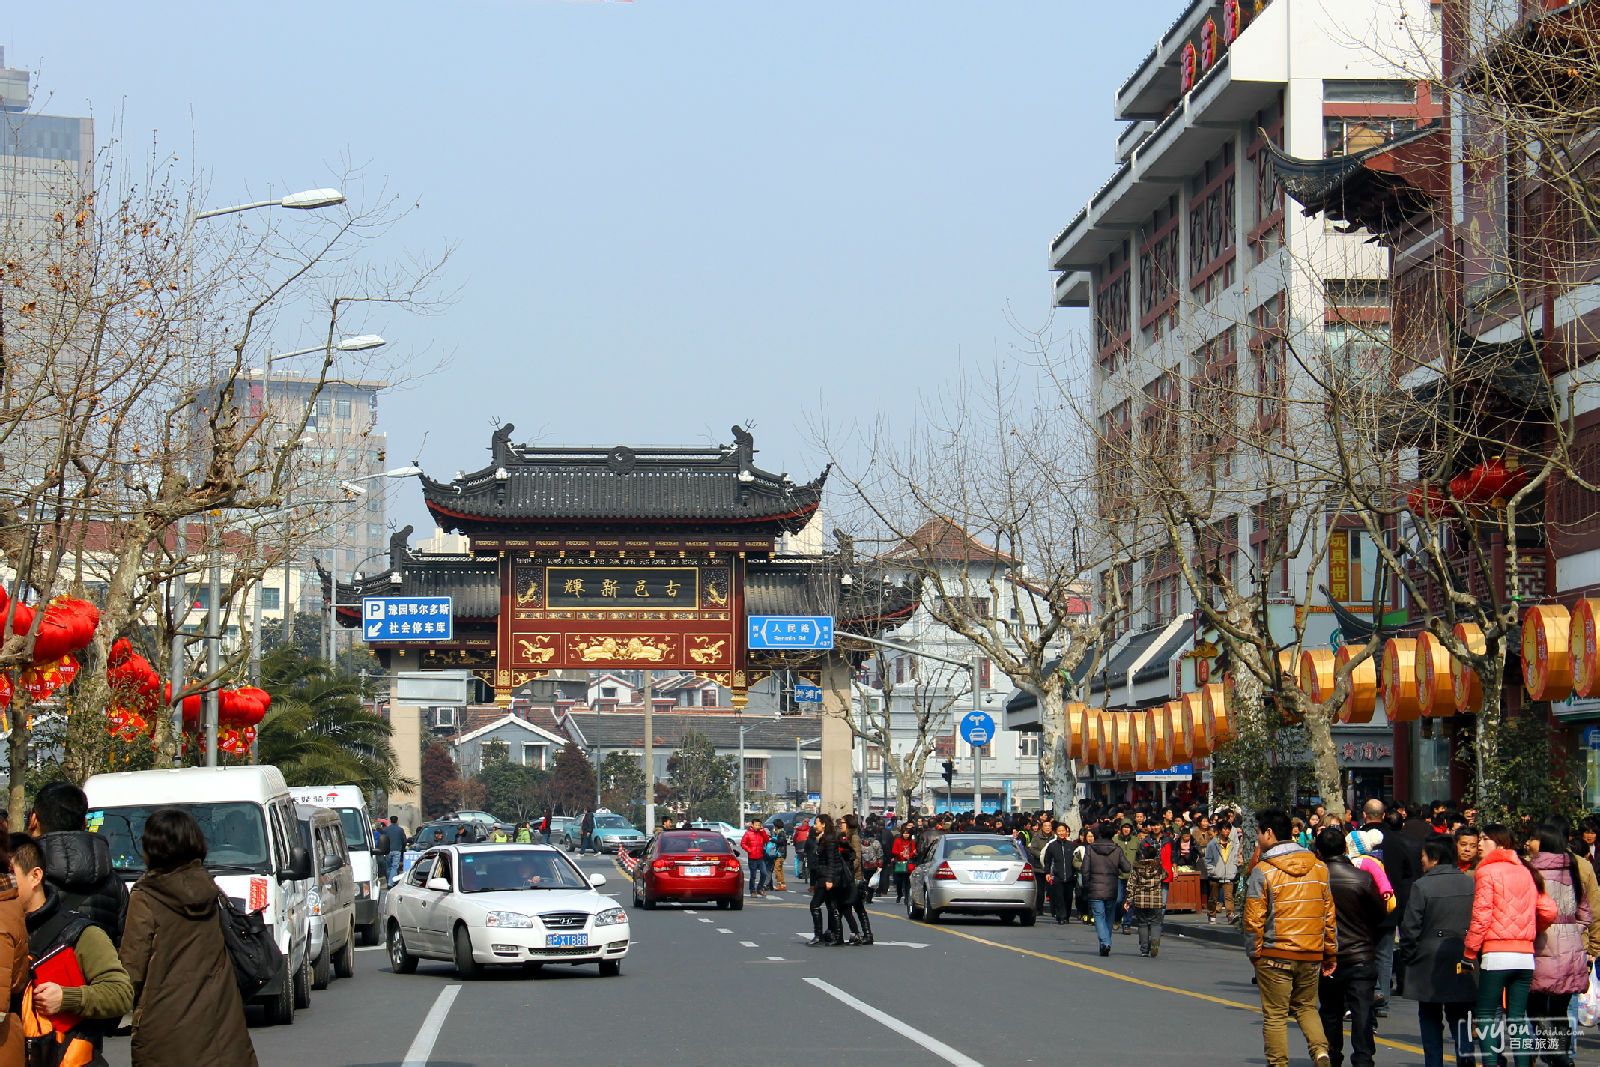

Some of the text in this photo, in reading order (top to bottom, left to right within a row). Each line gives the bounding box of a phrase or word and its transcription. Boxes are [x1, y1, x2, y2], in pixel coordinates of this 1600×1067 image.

[1330, 532, 1346, 599] 玩具世界
[388, 603, 450, 616] 豫园鄂尔多斯
[389, 621, 446, 634] 社会停车库
[772, 623, 810, 633] 人民路
[1341, 741, 1391, 761] 黄浦江
